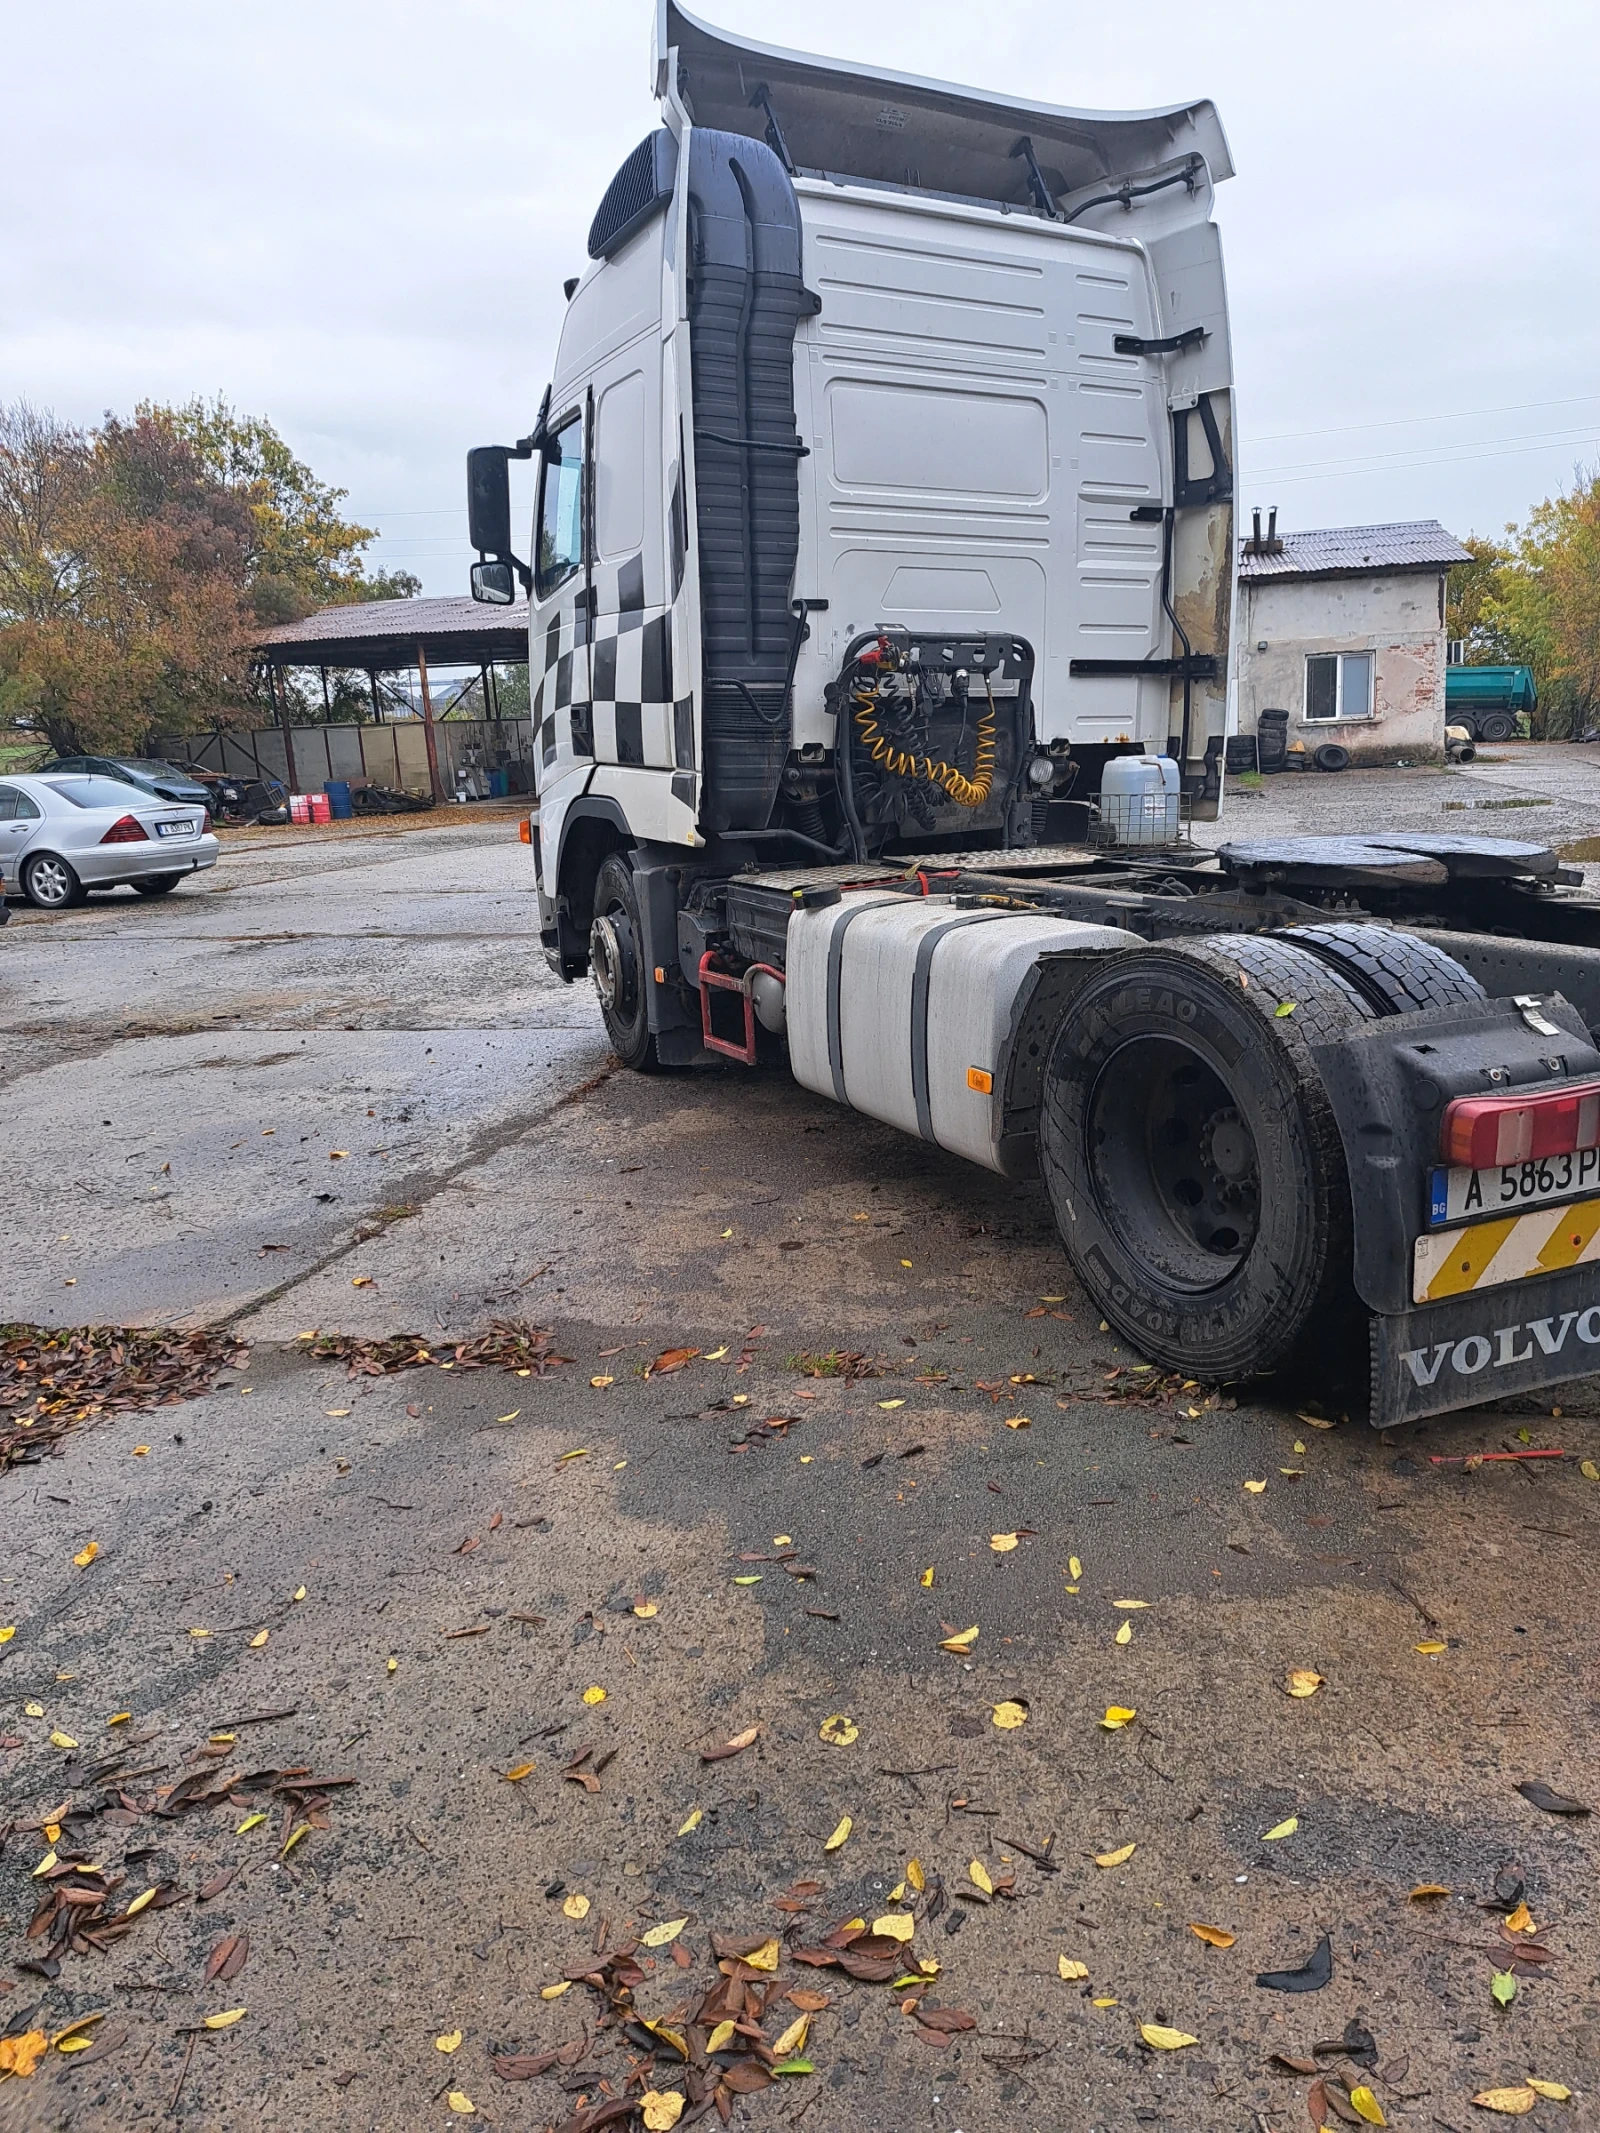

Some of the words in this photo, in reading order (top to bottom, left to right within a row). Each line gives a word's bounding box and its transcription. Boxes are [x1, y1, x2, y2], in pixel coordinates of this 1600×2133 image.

[1432, 1202, 1446, 1216] BG
[1464, 1169, 1483, 1211] A
[1501, 1153, 1573, 1202] 5863
[1579, 1149, 1600, 1186] P
[1398, 1305, 1600, 1387] VOLVO
